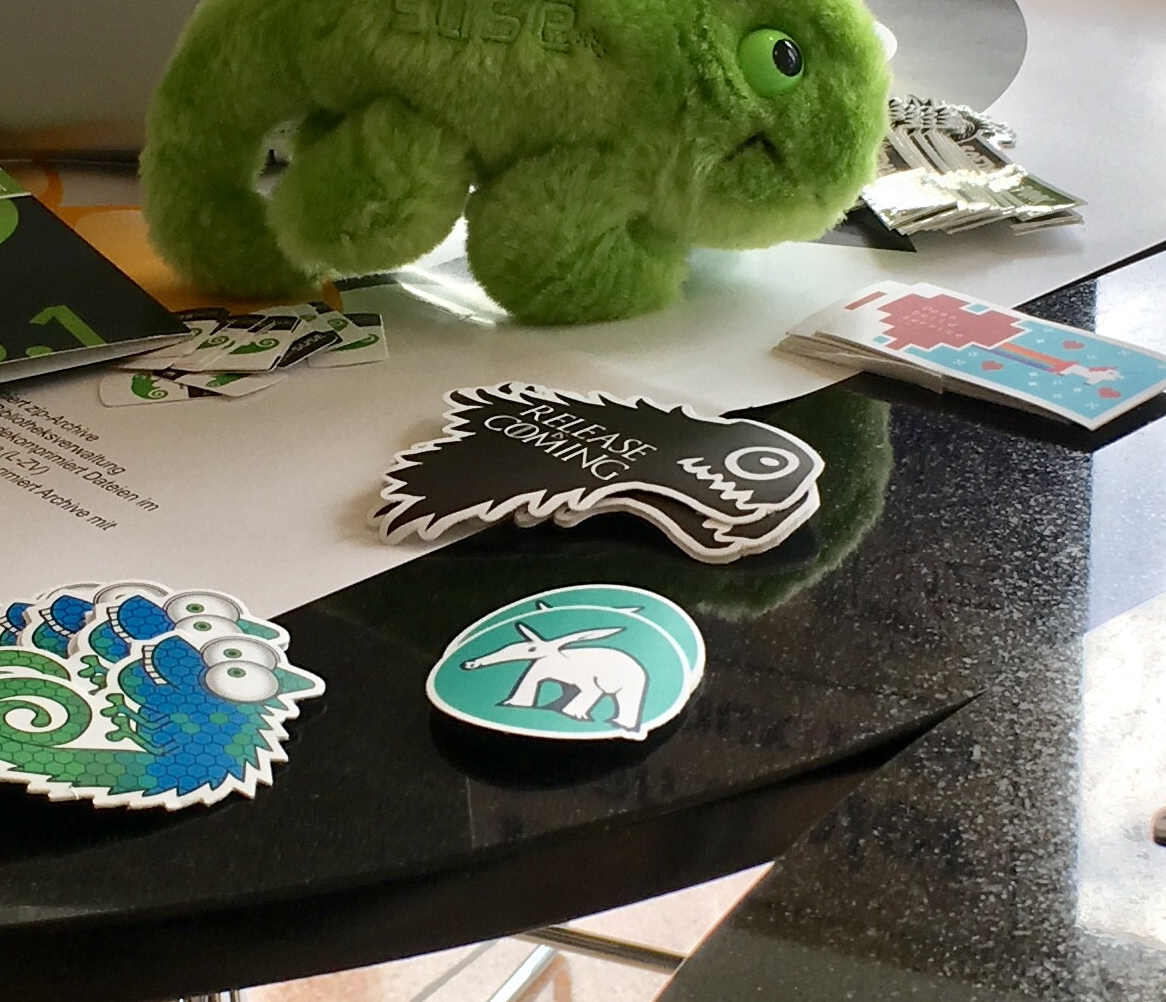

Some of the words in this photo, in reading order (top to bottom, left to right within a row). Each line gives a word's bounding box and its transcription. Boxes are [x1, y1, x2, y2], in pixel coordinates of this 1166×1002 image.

[23, 397, 100, 443] zip-Archive
[520, 404, 657, 461] RELEASE
[484, 414, 630, 481] COMING
[36, 488, 90, 518] Archive
[86, 512, 119, 531] mit
[83, 470, 139, 503] Dateien
[136, 496, 160, 512] im
